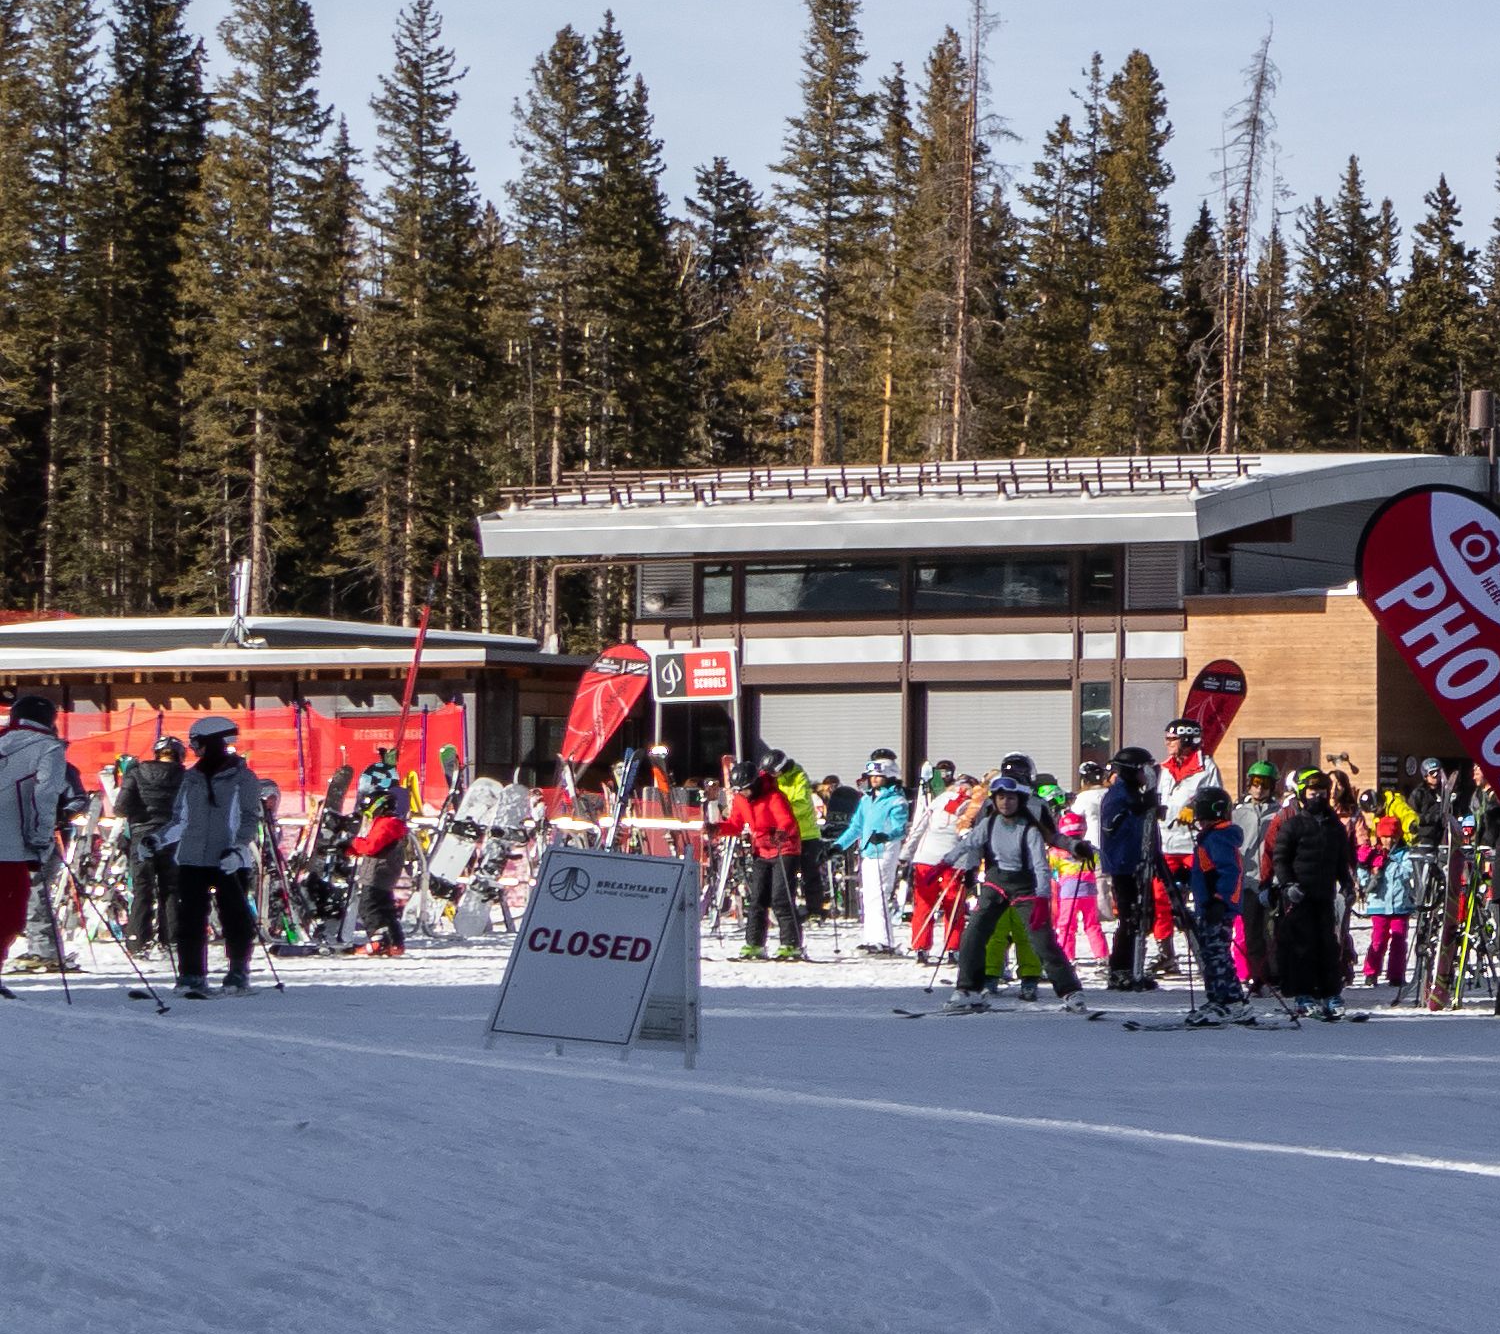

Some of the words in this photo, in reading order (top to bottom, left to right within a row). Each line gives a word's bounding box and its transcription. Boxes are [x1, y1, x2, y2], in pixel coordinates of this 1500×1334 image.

[694, 677, 727, 689] SCHOOLS
[597, 880, 668, 894] BREATHTAKER
[528, 927, 652, 962] CLOSED
